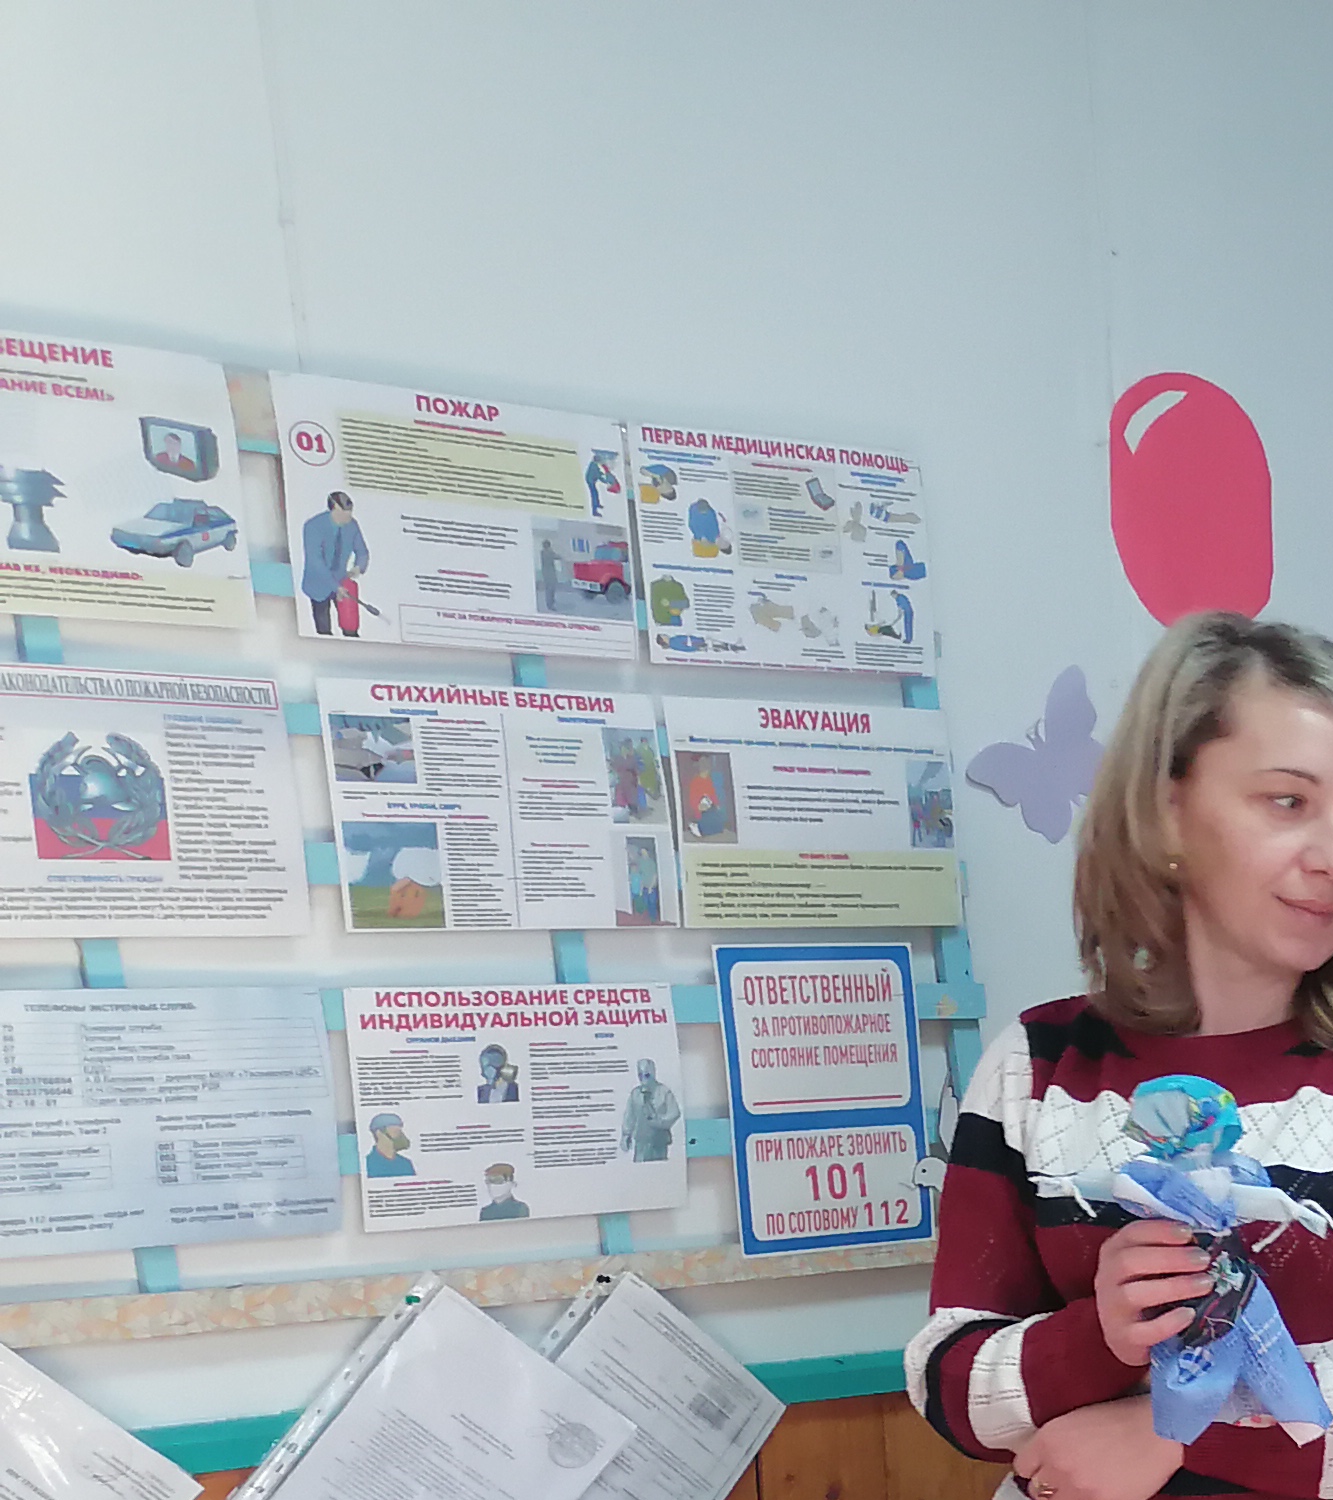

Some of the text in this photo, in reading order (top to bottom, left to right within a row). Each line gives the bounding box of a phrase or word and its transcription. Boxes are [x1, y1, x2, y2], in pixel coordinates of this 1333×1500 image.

[415, 394, 499, 422] ПОЖАР
[296, 431, 327, 454] 01
[641, 427, 707, 448] ПЕРВАЯ
[712, 434, 836, 464] МЕДИЦИНСКАЯ
[839, 449, 909, 473] ПОМОЩЬ
[190, 683, 273, 705] БЕЗОПАСНОСТИ
[370, 683, 615, 713] СТИХИЙНЫЕ БЕДСТВИЯ
[758, 707, 871, 736] ЭВАКУАЦИЯ
[375, 988, 651, 1008] ИСПОЛЬЗОВАНИЕ СРЕДСТВ
[743, 967, 893, 1006] ОТВЕТСТВЕННЫЙ
[360, 1007, 667, 1031] ИНДИВИДУАЛЬНОЙ ЗАЩИТЫ
[752, 1013, 891, 1037] ЗА ПРОТИВОПОЖАРНОЕ
[751, 1043, 899, 1069] СОСТОЯНИЕ ПОМЕЩЕНИЯ
[755, 1131, 907, 1162] ПРИ ПОЖАРЕ ЗВОНИТЬ
[805, 1162, 868, 1201] 101
[766, 1199, 909, 1236] ПО СОТОВОМУ 112
